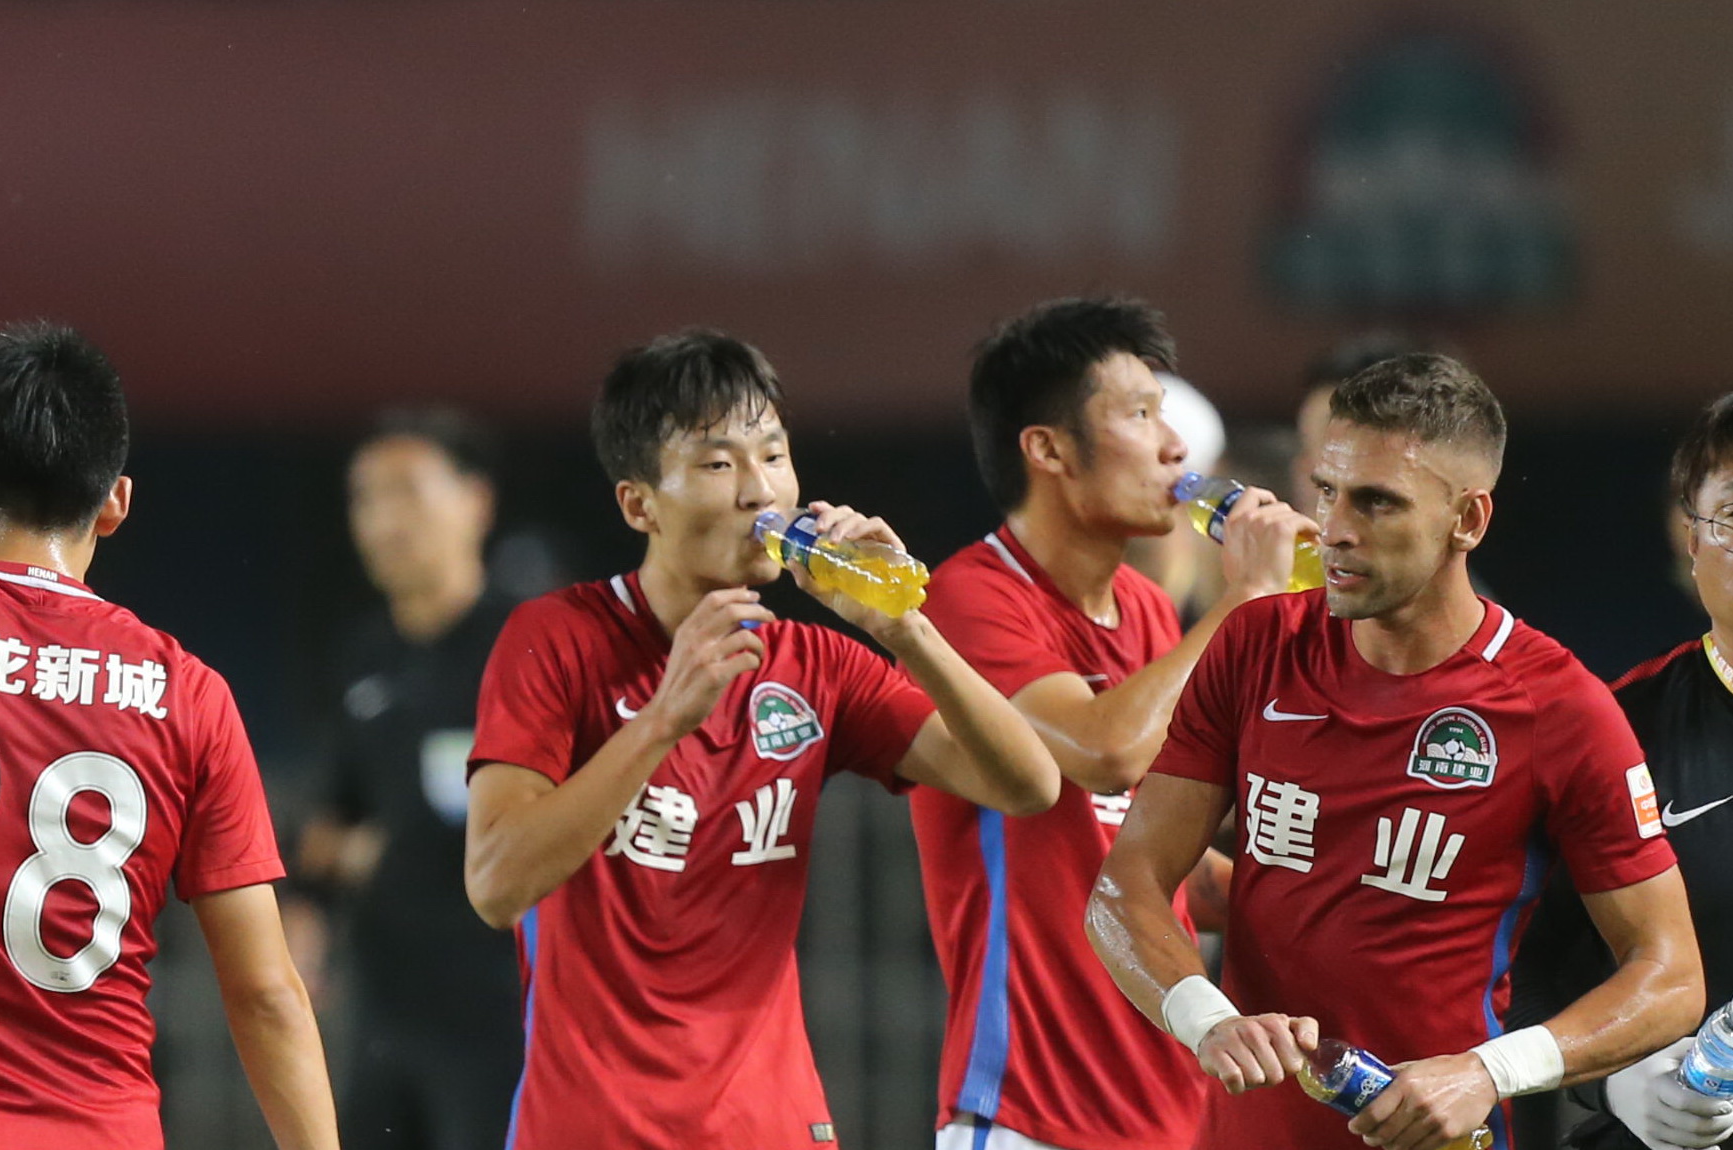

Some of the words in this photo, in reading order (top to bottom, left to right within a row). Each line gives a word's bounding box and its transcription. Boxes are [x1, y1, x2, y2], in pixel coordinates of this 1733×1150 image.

[28, 566, 58, 582] HENAN
[604, 778, 798, 873] 建业
[1245, 772, 1466, 902] 建业
